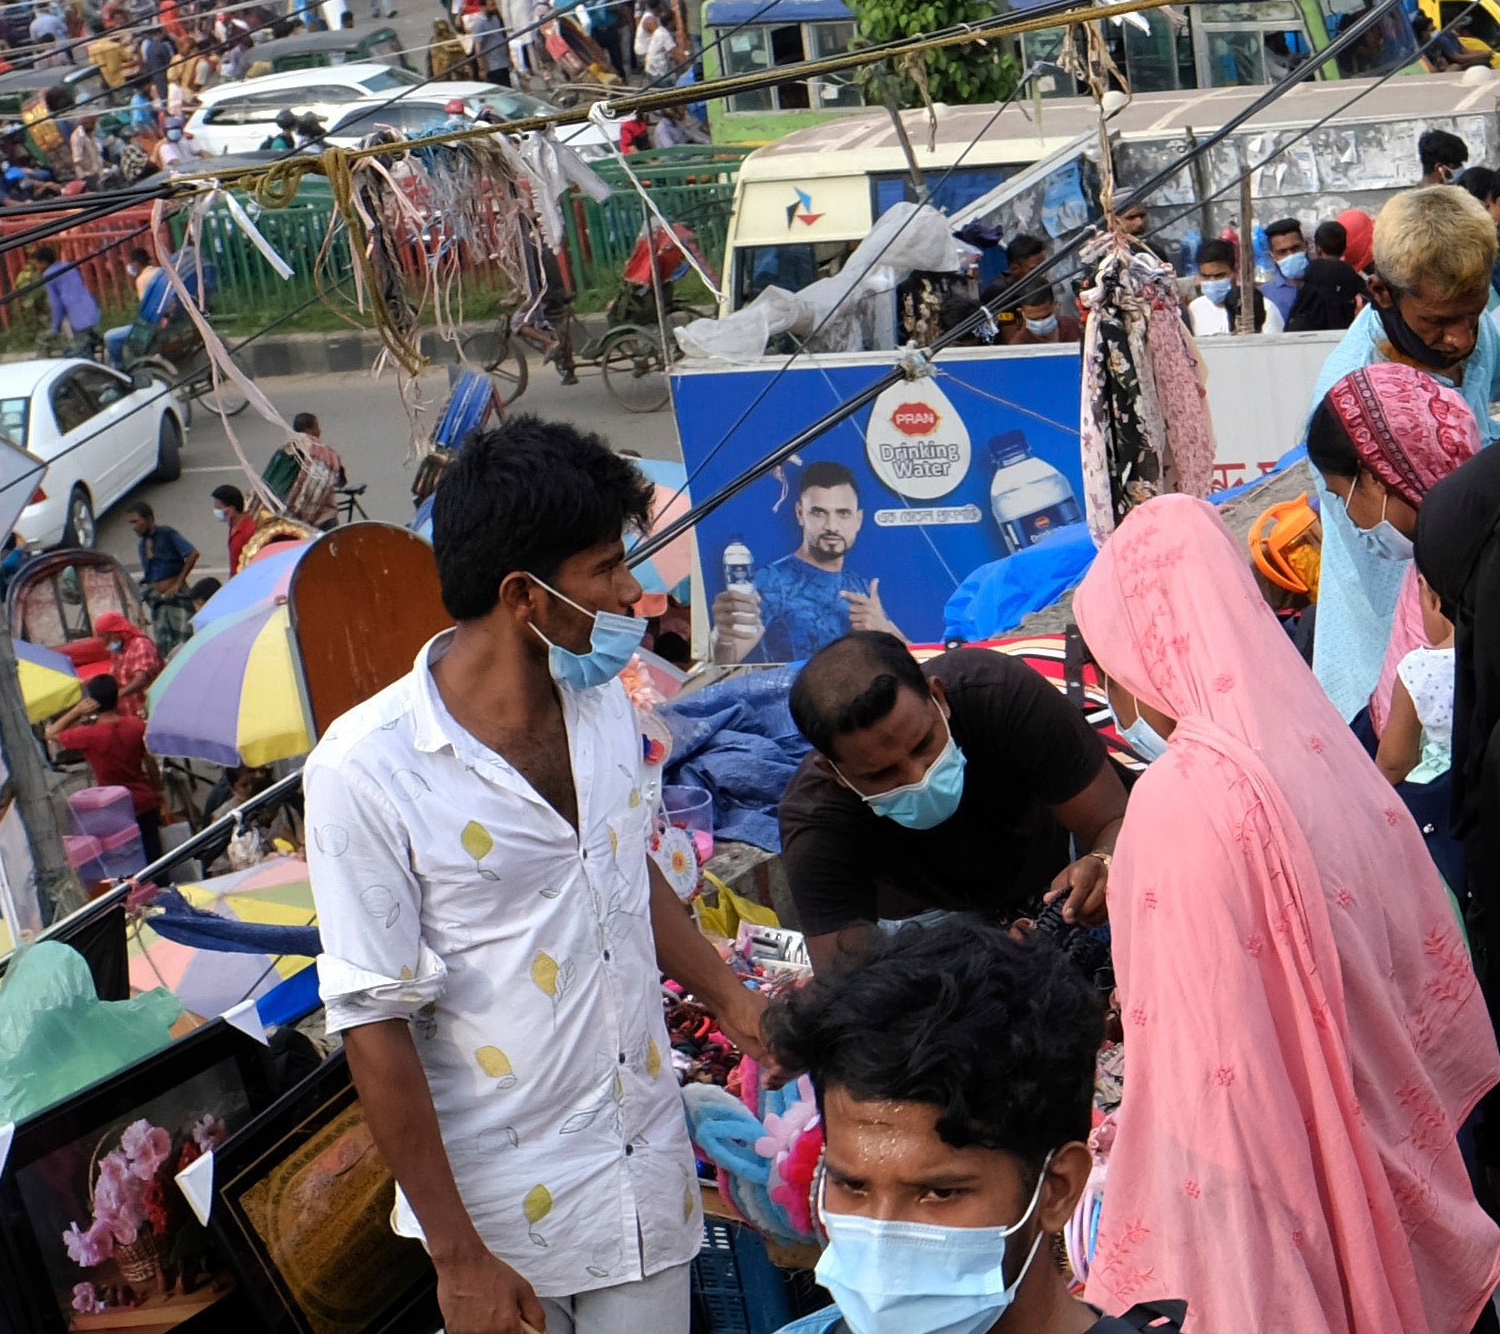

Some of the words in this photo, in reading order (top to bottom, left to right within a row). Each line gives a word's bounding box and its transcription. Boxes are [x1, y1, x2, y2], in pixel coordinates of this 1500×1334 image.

[895, 409, 935, 428] PRAN
[879, 441, 960, 463] Drinking
[892, 458, 951, 480] Water
